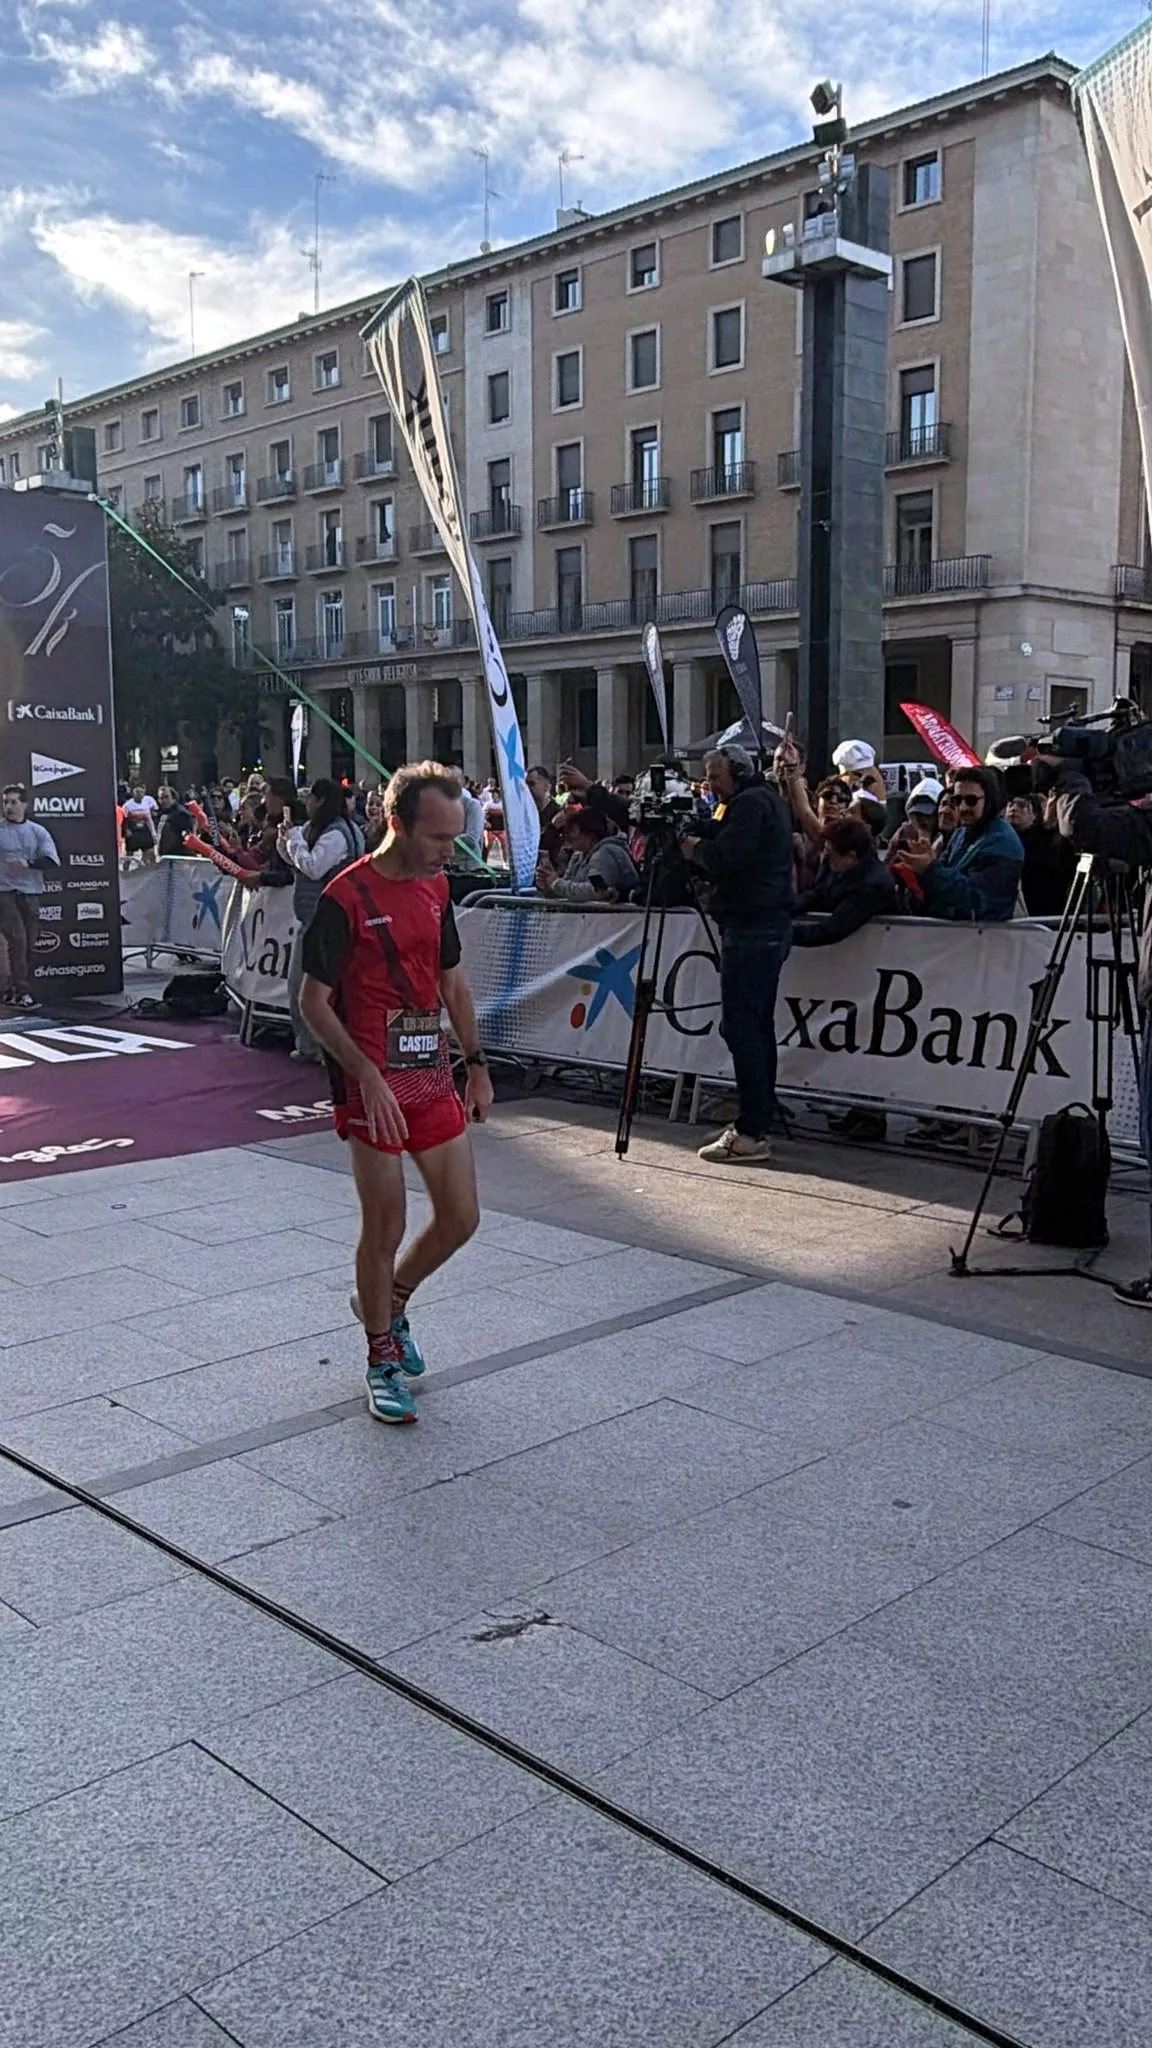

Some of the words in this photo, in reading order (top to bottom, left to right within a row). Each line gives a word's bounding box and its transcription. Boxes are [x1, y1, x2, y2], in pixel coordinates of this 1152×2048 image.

[34, 705, 95, 721] CaixaBank
[69, 854, 105, 865] LACASA
[67, 880, 110, 888] CHANGAN
[662, 950, 1071, 1078] CxaBank
